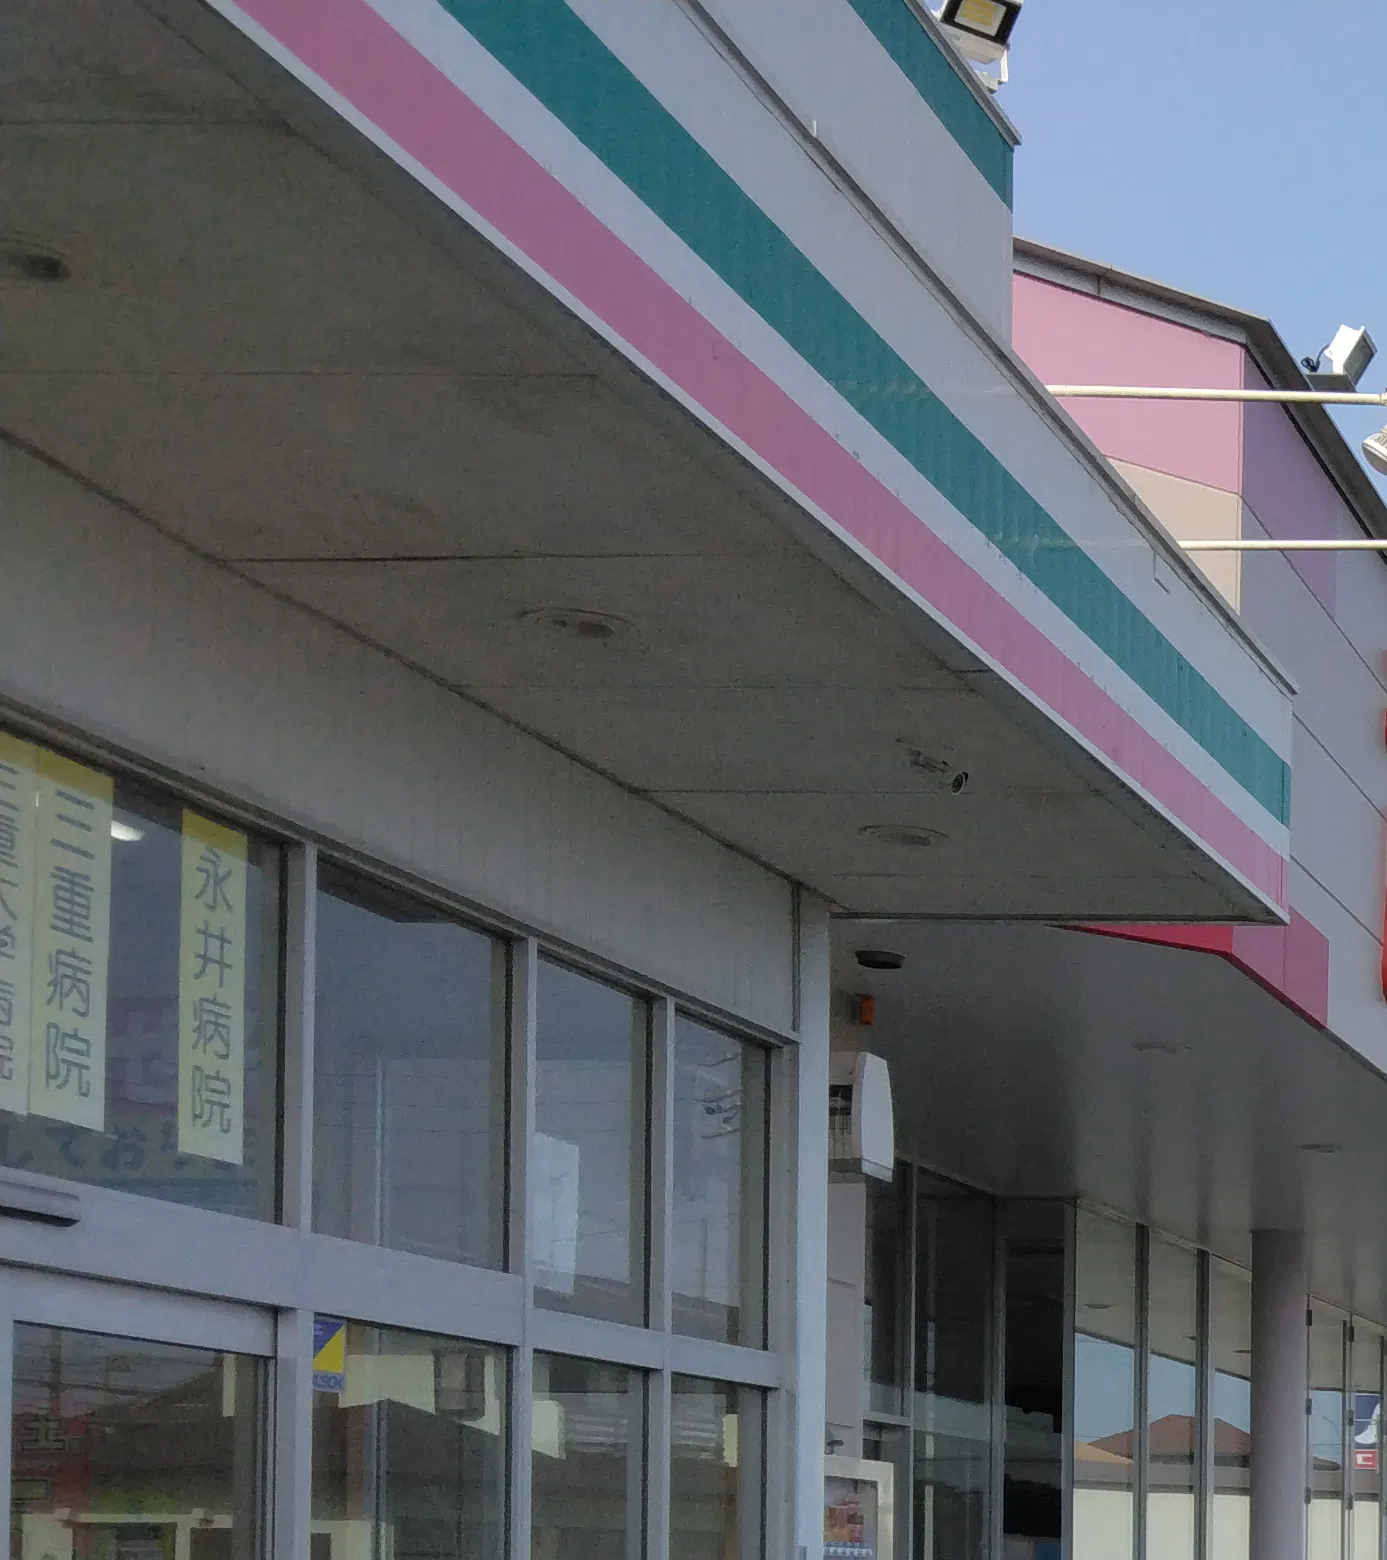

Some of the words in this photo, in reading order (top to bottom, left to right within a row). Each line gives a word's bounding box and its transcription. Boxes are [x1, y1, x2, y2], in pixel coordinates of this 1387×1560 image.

[45, 789, 96, 1099] 三重病院
[190, 847, 234, 1135] 永井病院
